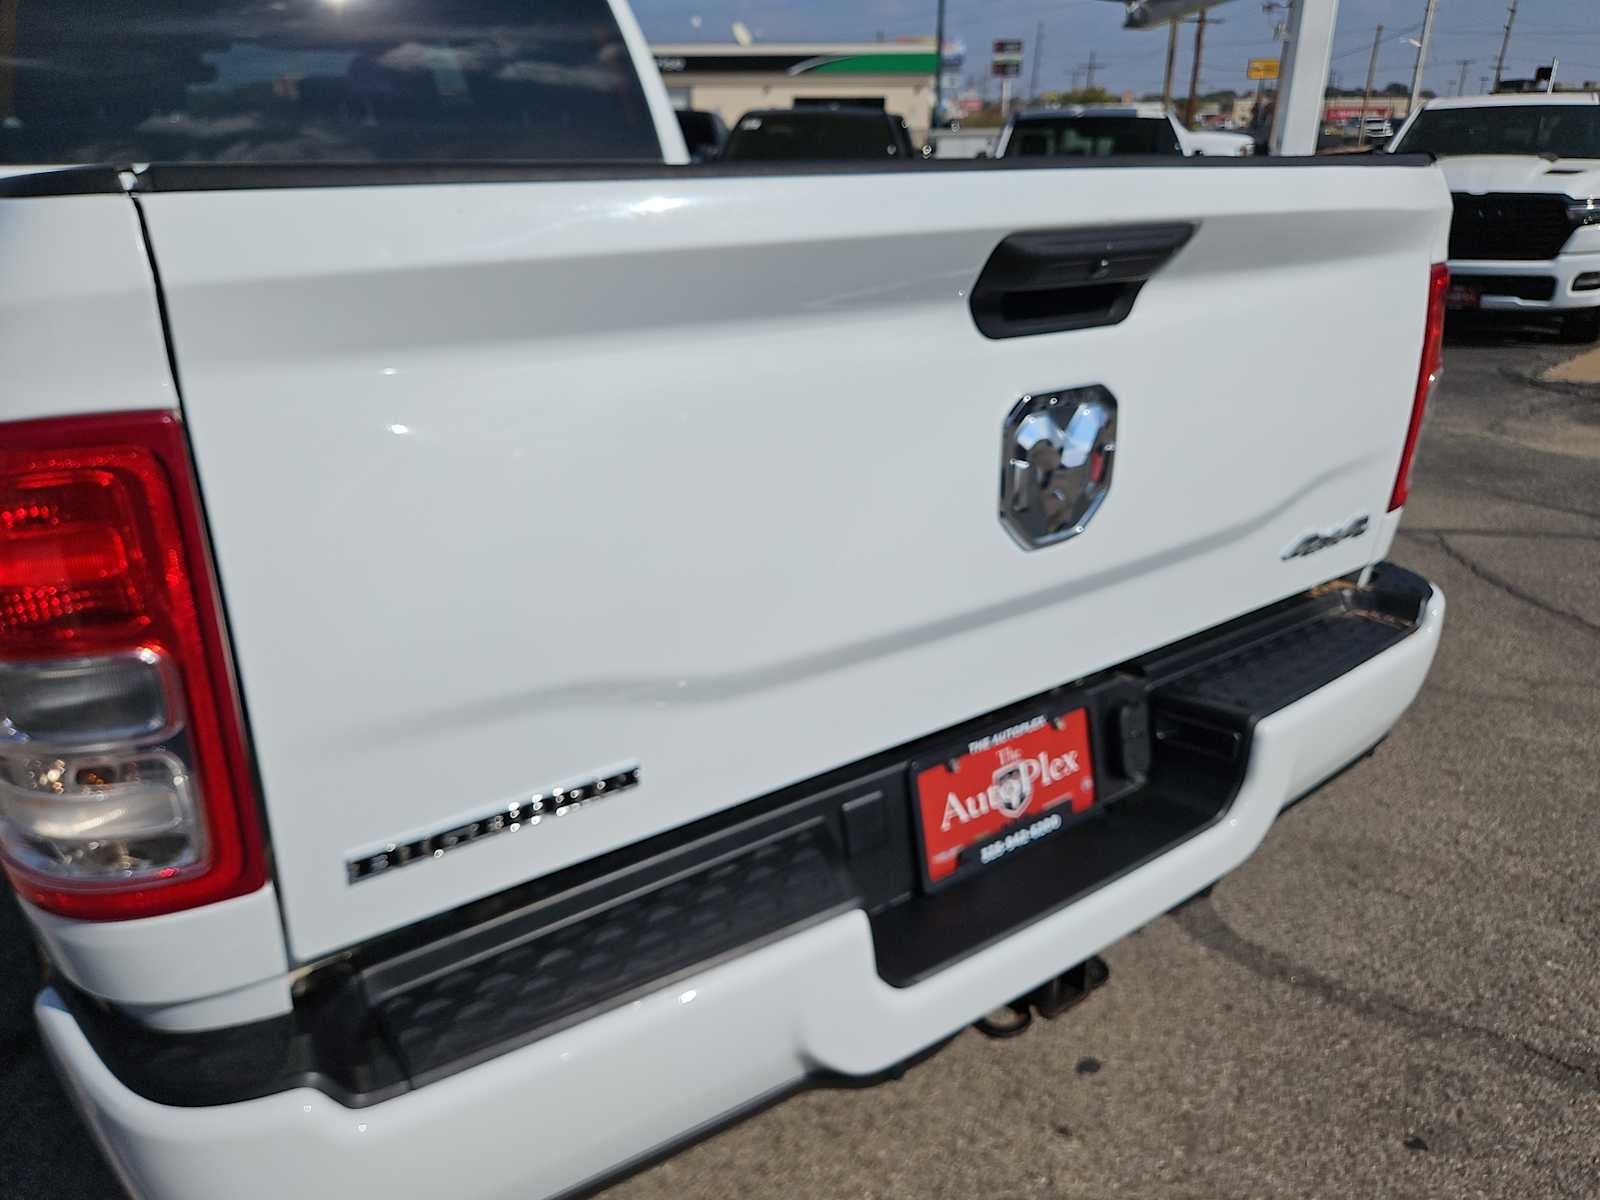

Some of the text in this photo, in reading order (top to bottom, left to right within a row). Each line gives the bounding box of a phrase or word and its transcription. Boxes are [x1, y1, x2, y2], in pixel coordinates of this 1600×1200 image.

[967, 714, 1048, 754] THE AUTOPLEX
[997, 746, 1022, 765] The
